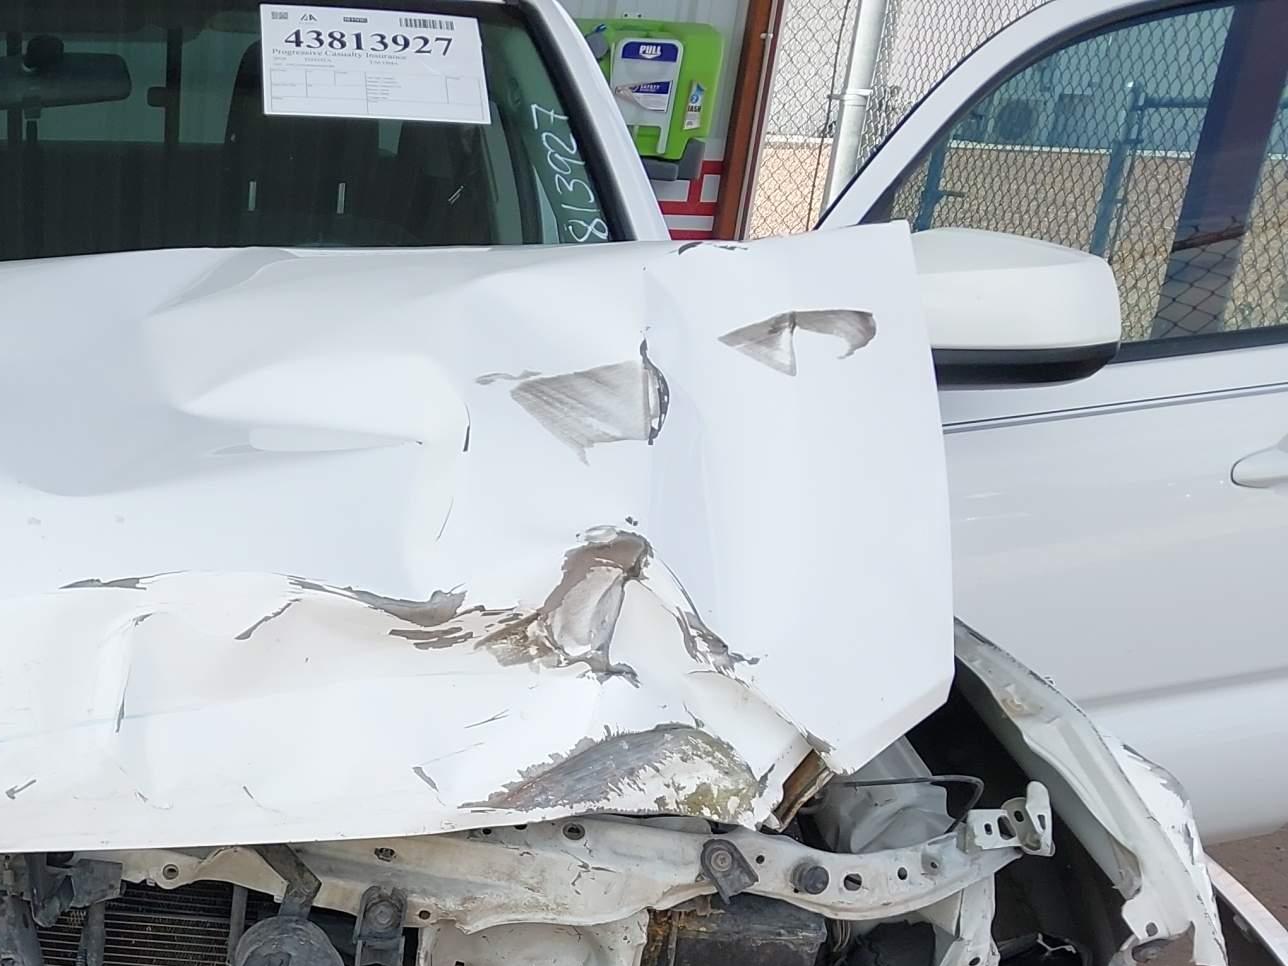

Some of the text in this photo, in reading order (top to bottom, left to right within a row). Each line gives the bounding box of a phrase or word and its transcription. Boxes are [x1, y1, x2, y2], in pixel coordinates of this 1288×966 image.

[284, 28, 454, 57] 43813927
[272, 48, 408, 60] Progressive Casualty Insurance
[639, 45, 662, 55] PULL
